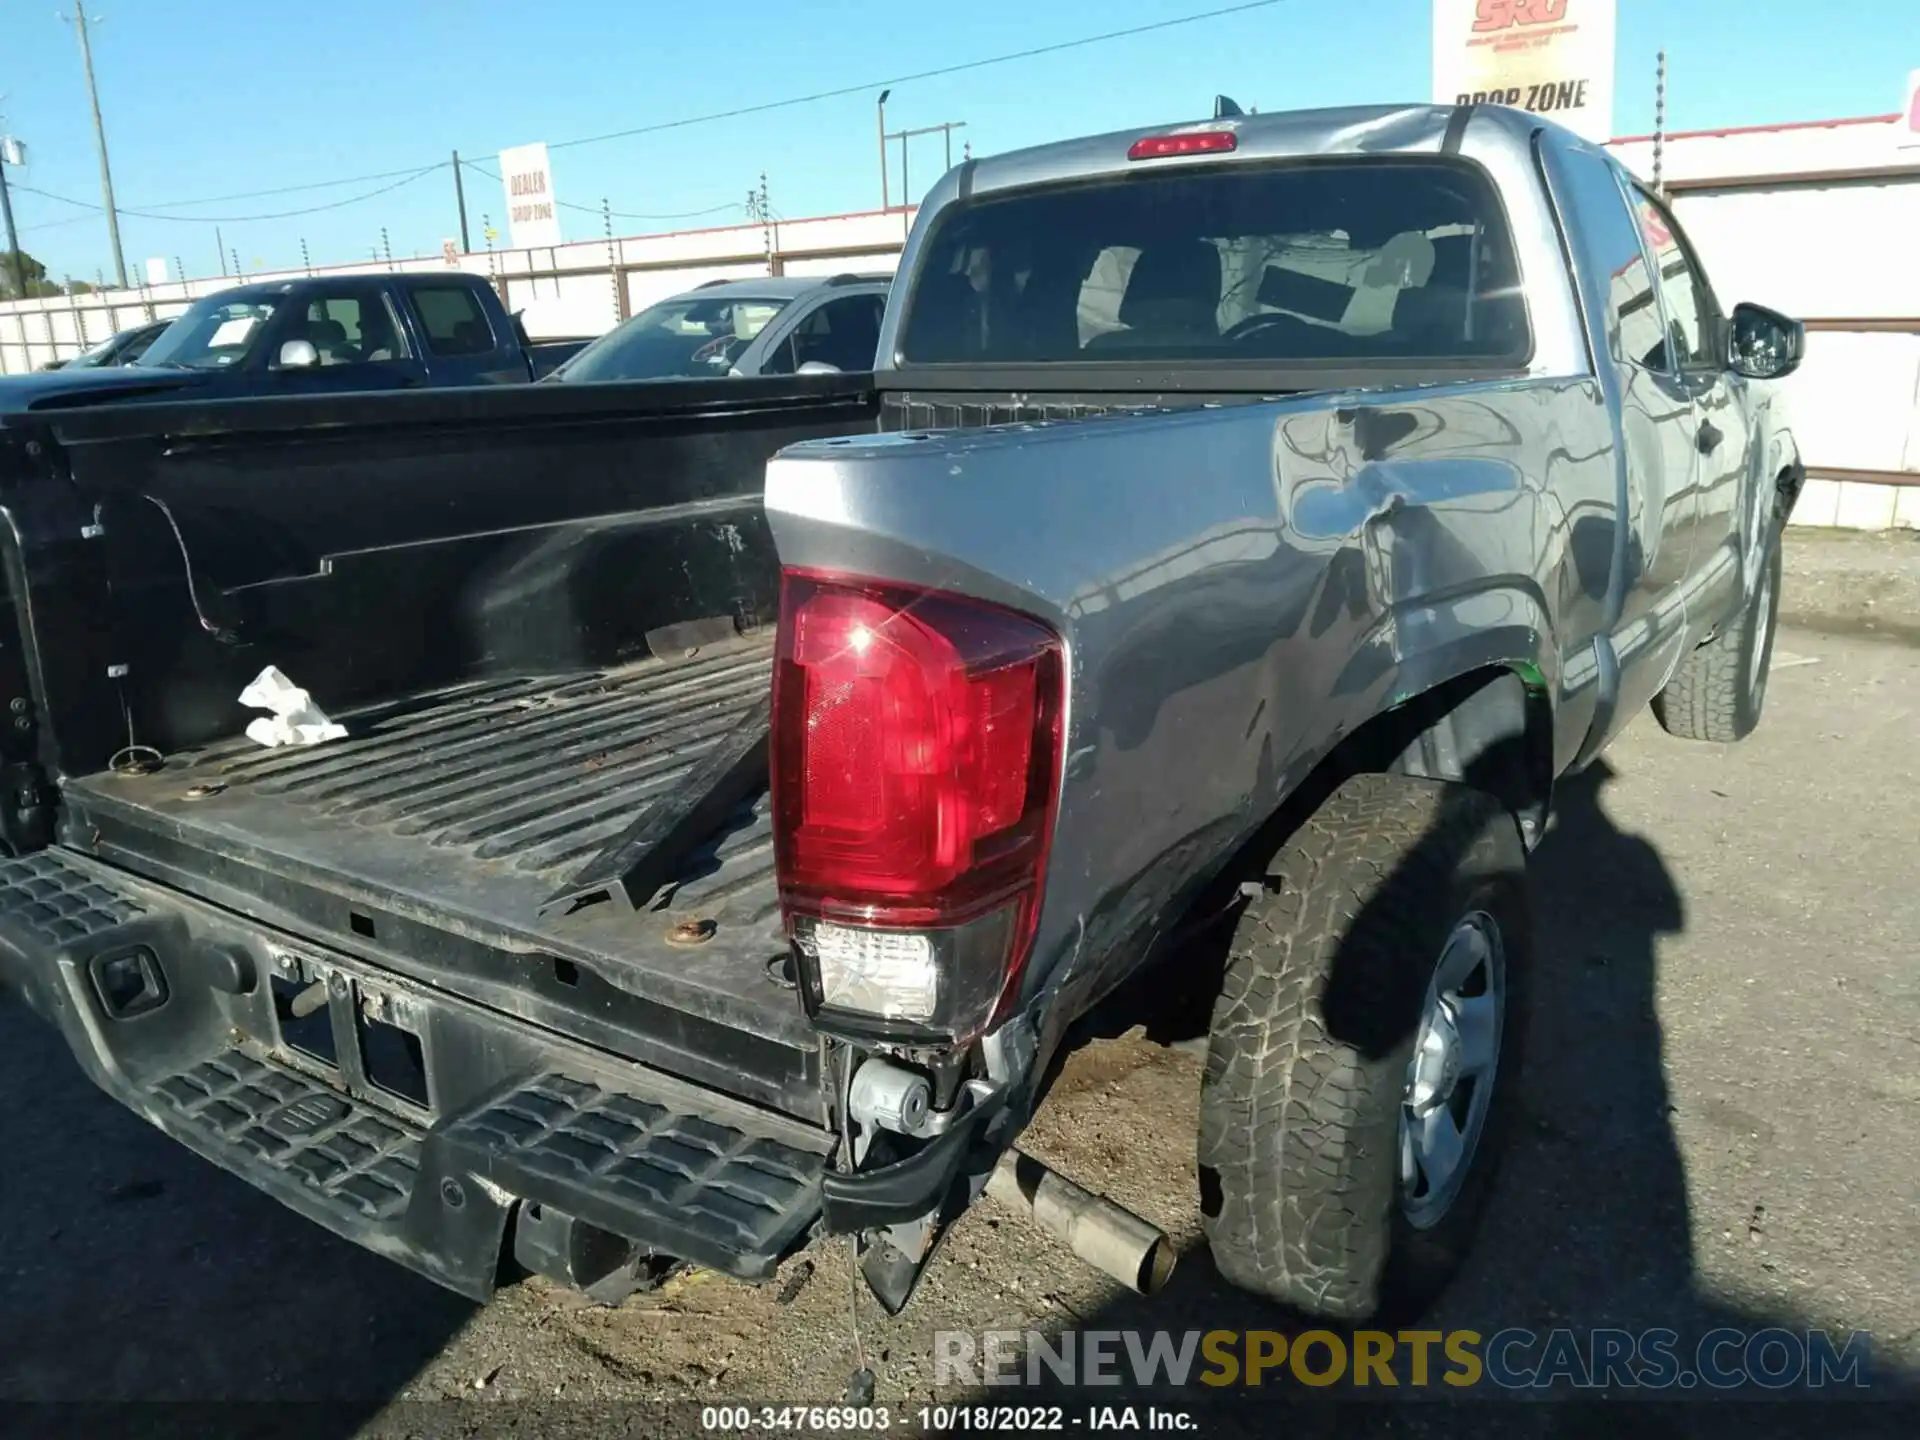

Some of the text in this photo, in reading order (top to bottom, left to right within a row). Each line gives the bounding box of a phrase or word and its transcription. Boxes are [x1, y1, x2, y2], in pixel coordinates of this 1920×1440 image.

[1525, 79, 1589, 113] ZONE
[511, 170, 546, 197] DEALER
[534, 203, 553, 221] ZONE
